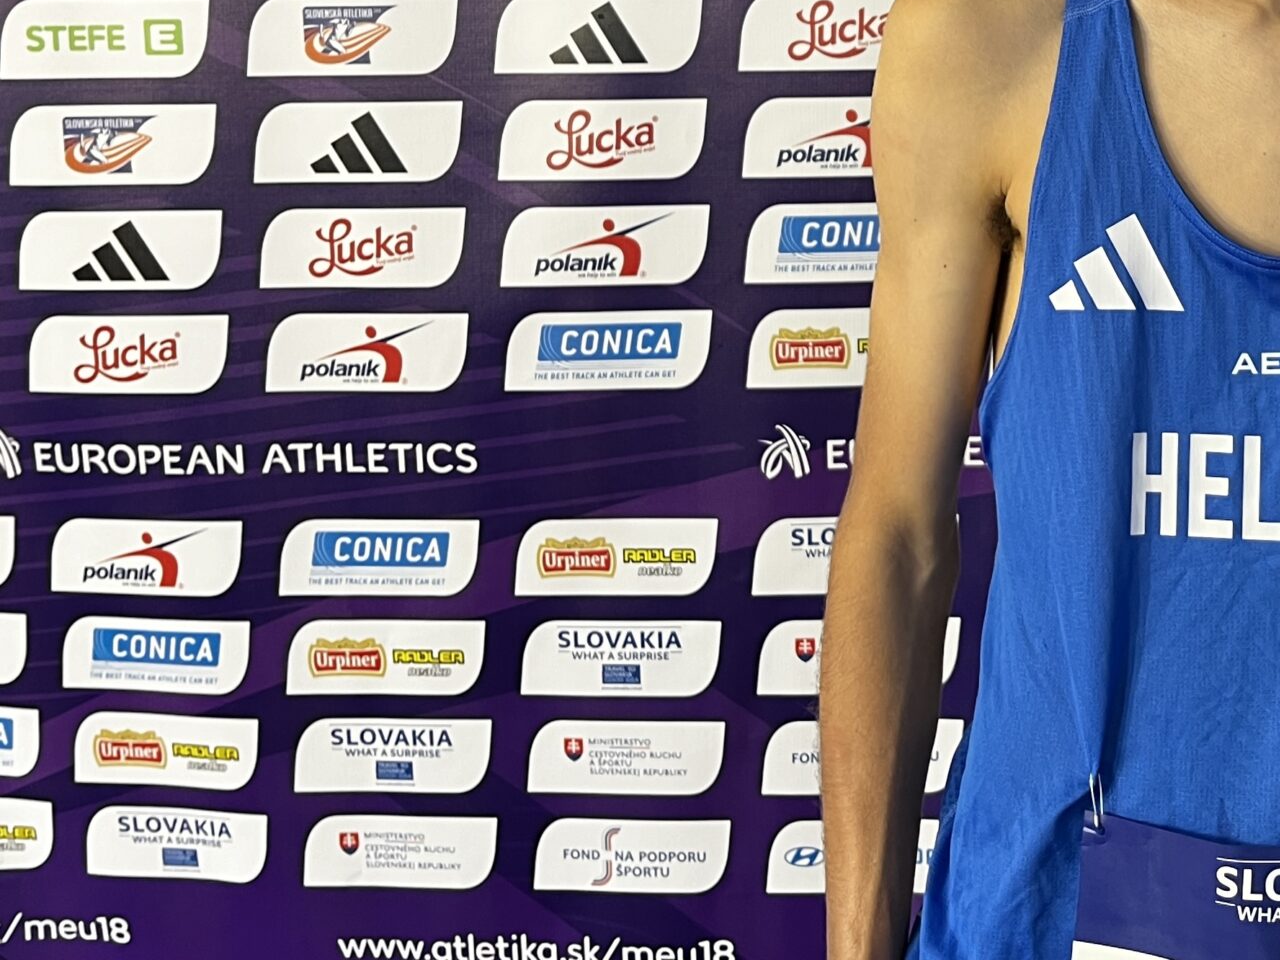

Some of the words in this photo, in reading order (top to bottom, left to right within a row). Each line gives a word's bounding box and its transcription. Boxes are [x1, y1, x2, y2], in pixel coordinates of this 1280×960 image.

[26, 24, 126, 53] STEFE
[801, 220, 881, 248] CONI
[560, 328, 673, 357] CONICA
[777, 338, 843, 366] Urpiner
[34, 441, 245, 476] EUROPEAN
[262, 442, 478, 475] ATHLETICS
[333, 536, 441, 562] CONICA
[543, 552, 609, 572] Urpiner
[112, 633, 214, 662] CONICA
[557, 630, 682, 650] SLOVAKIA
[315, 649, 380, 669] Urpiner
[572, 651, 605, 661] WHAT
[607, 651, 615, 661] A
[617, 650, 670, 661] SURPRISE
[330, 728, 453, 747] SLOVAKIA
[99, 741, 160, 762] Urpiner
[345, 748, 378, 758] WHAT
[380, 748, 388, 758] A
[390, 748, 441, 759] SURPRISE
[118, 816, 232, 840] SLOVAKIA
[132, 835, 164, 845] WHAT
[166, 837, 174, 845] A
[175, 837, 223, 849] SURPRISE
[563, 848, 600, 862] FOND
[614, 850, 634, 863] NA
[638, 850, 707, 864] PODPORU
[616, 864, 671, 879] ŠPORTU
